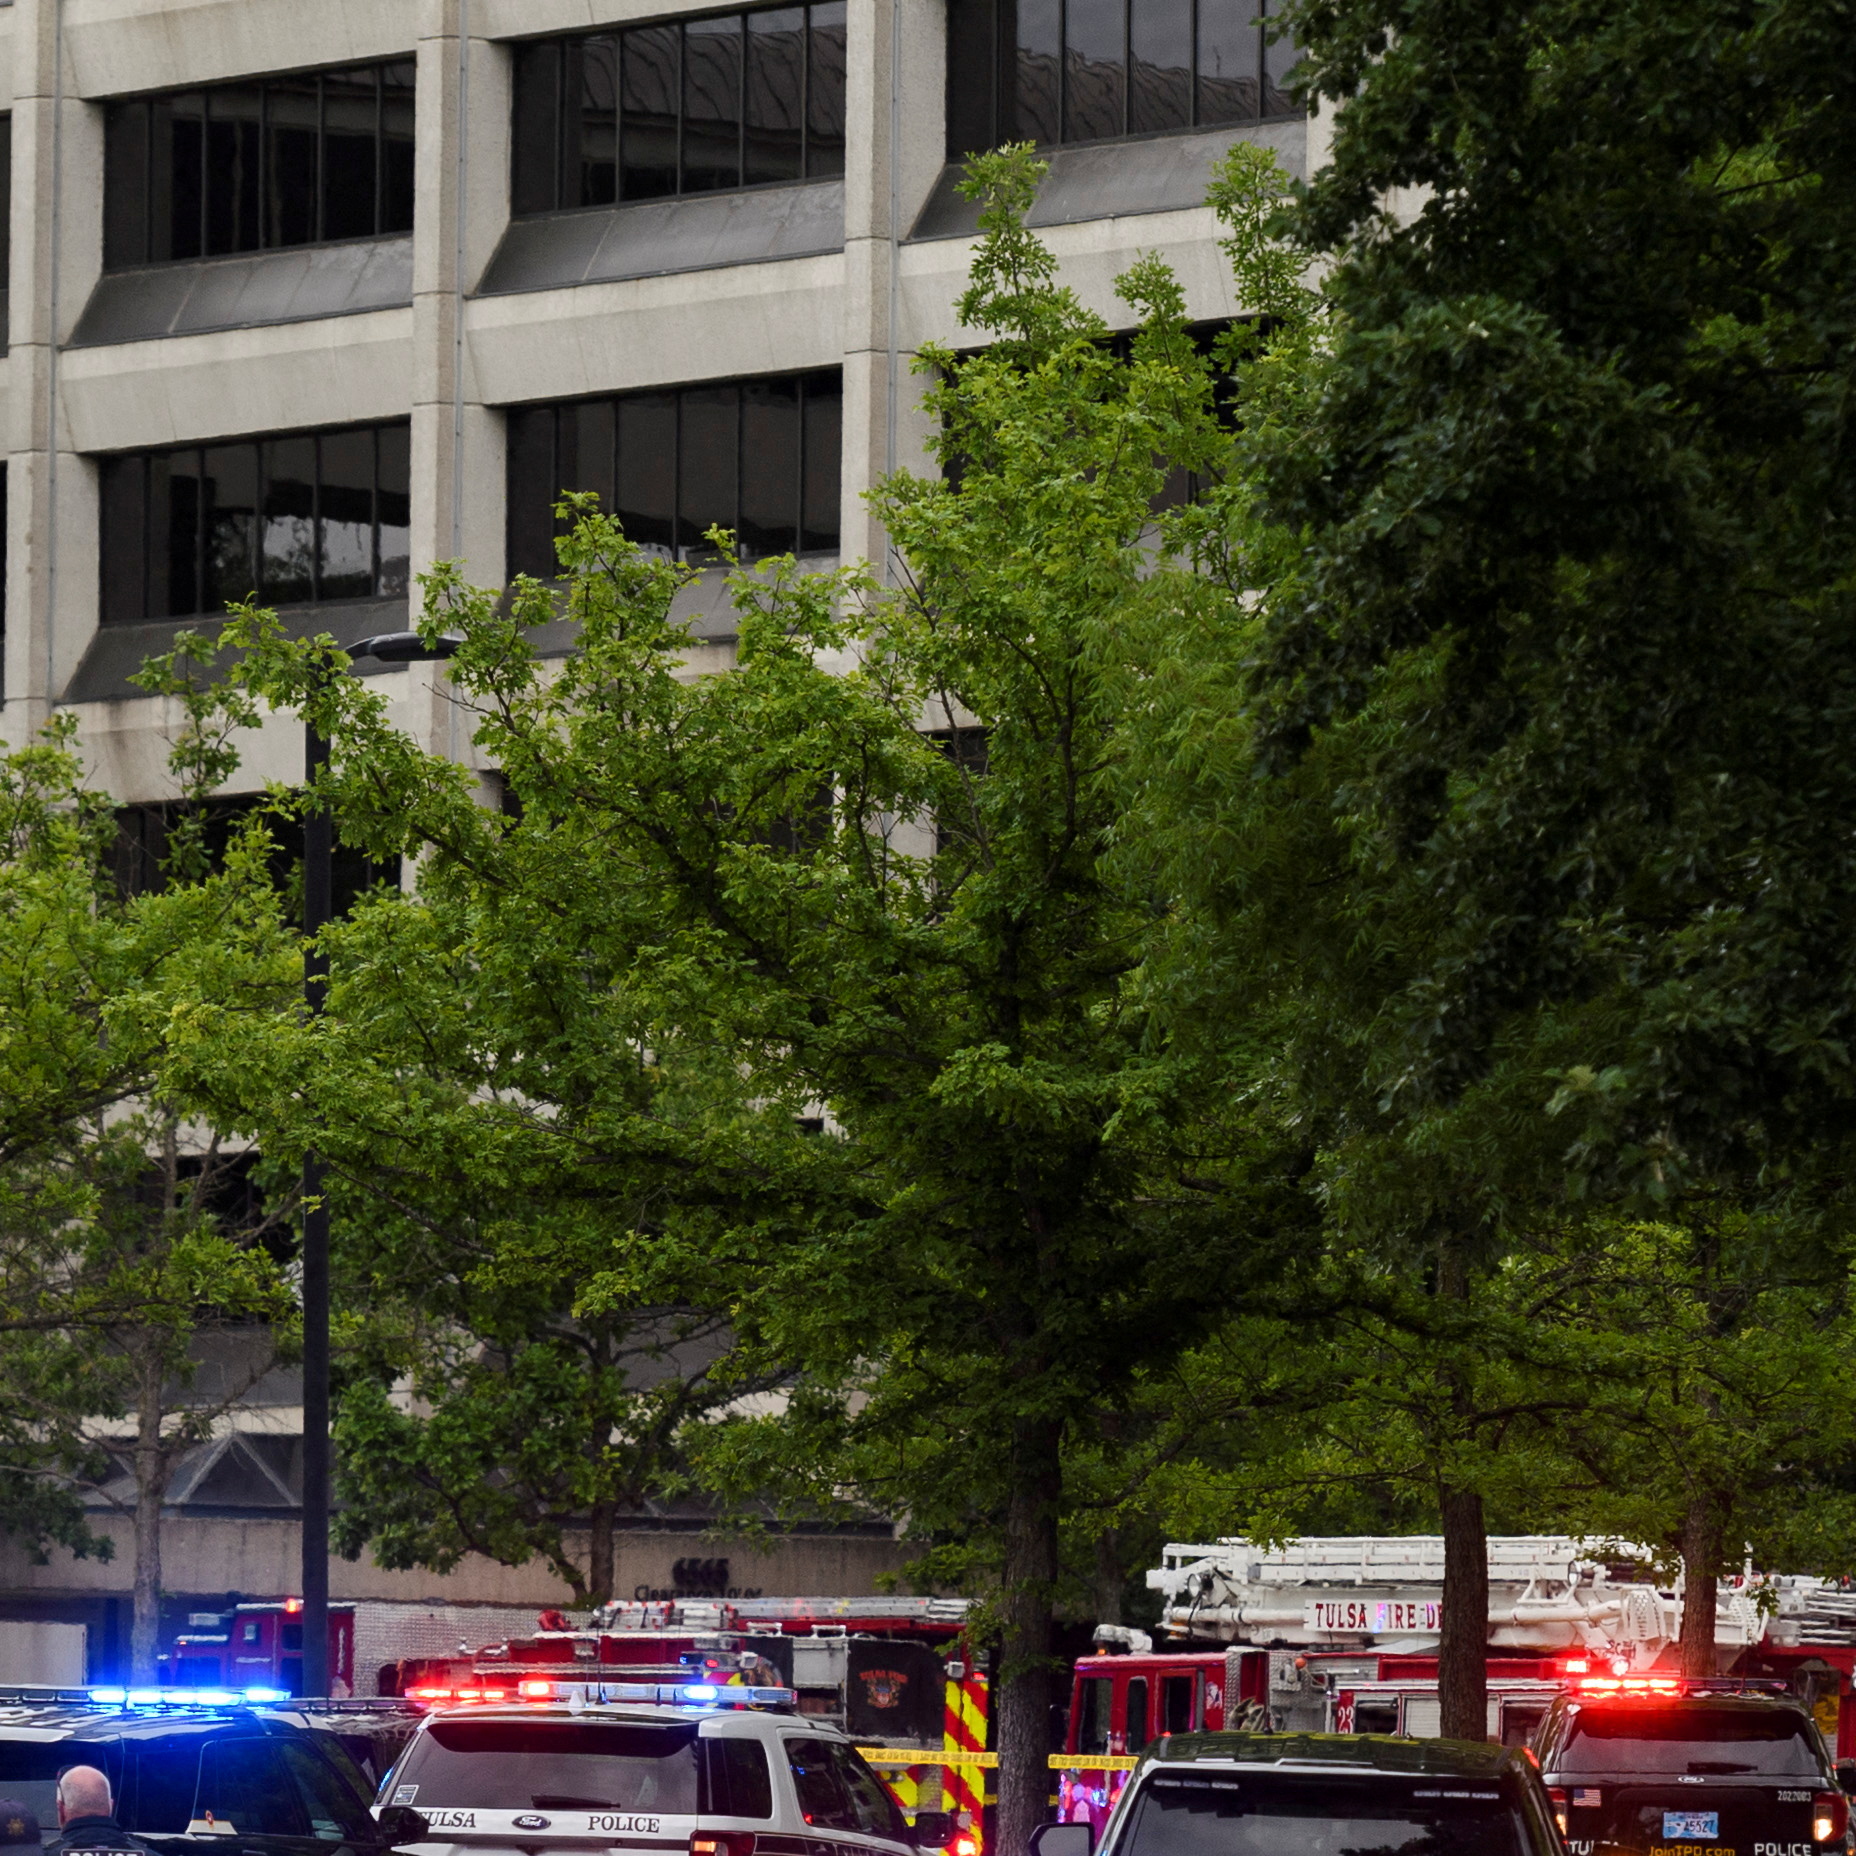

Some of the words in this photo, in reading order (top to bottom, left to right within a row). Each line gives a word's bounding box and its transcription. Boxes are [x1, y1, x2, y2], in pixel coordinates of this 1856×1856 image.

[1315, 1602, 1367, 1629] TULSA
[1337, 1705, 1354, 1734] 23
[587, 1815, 660, 1834] POLICE
